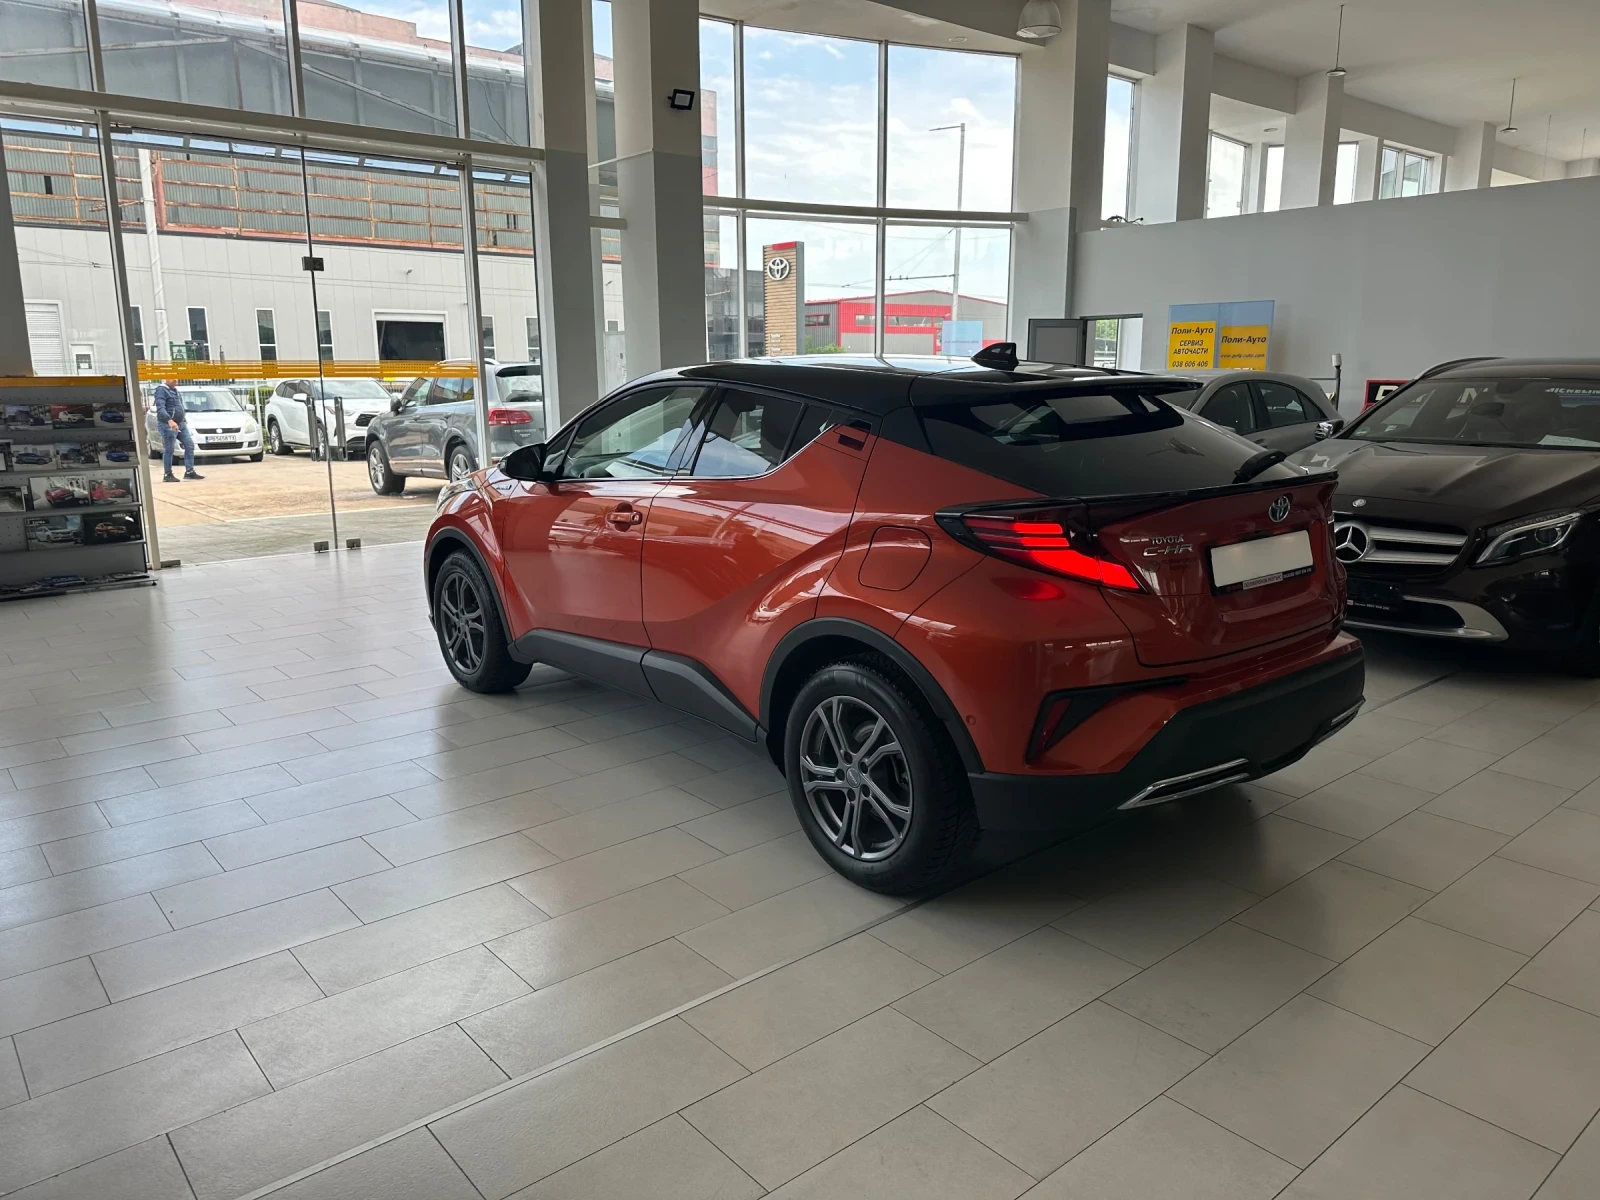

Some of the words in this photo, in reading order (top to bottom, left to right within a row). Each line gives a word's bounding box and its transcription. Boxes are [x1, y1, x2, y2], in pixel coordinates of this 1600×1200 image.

[1171, 326, 1214, 336] Поли-Ауто
[1179, 339, 1204, 347] СЕРВИЗ
[1221, 335, 1267, 345] Поли-Ауто
[1173, 347, 1209, 355] АВТОЧАСТИ
[1150, 534, 1184, 545] TOYOTA
[1143, 543, 1194, 557] C-HR
